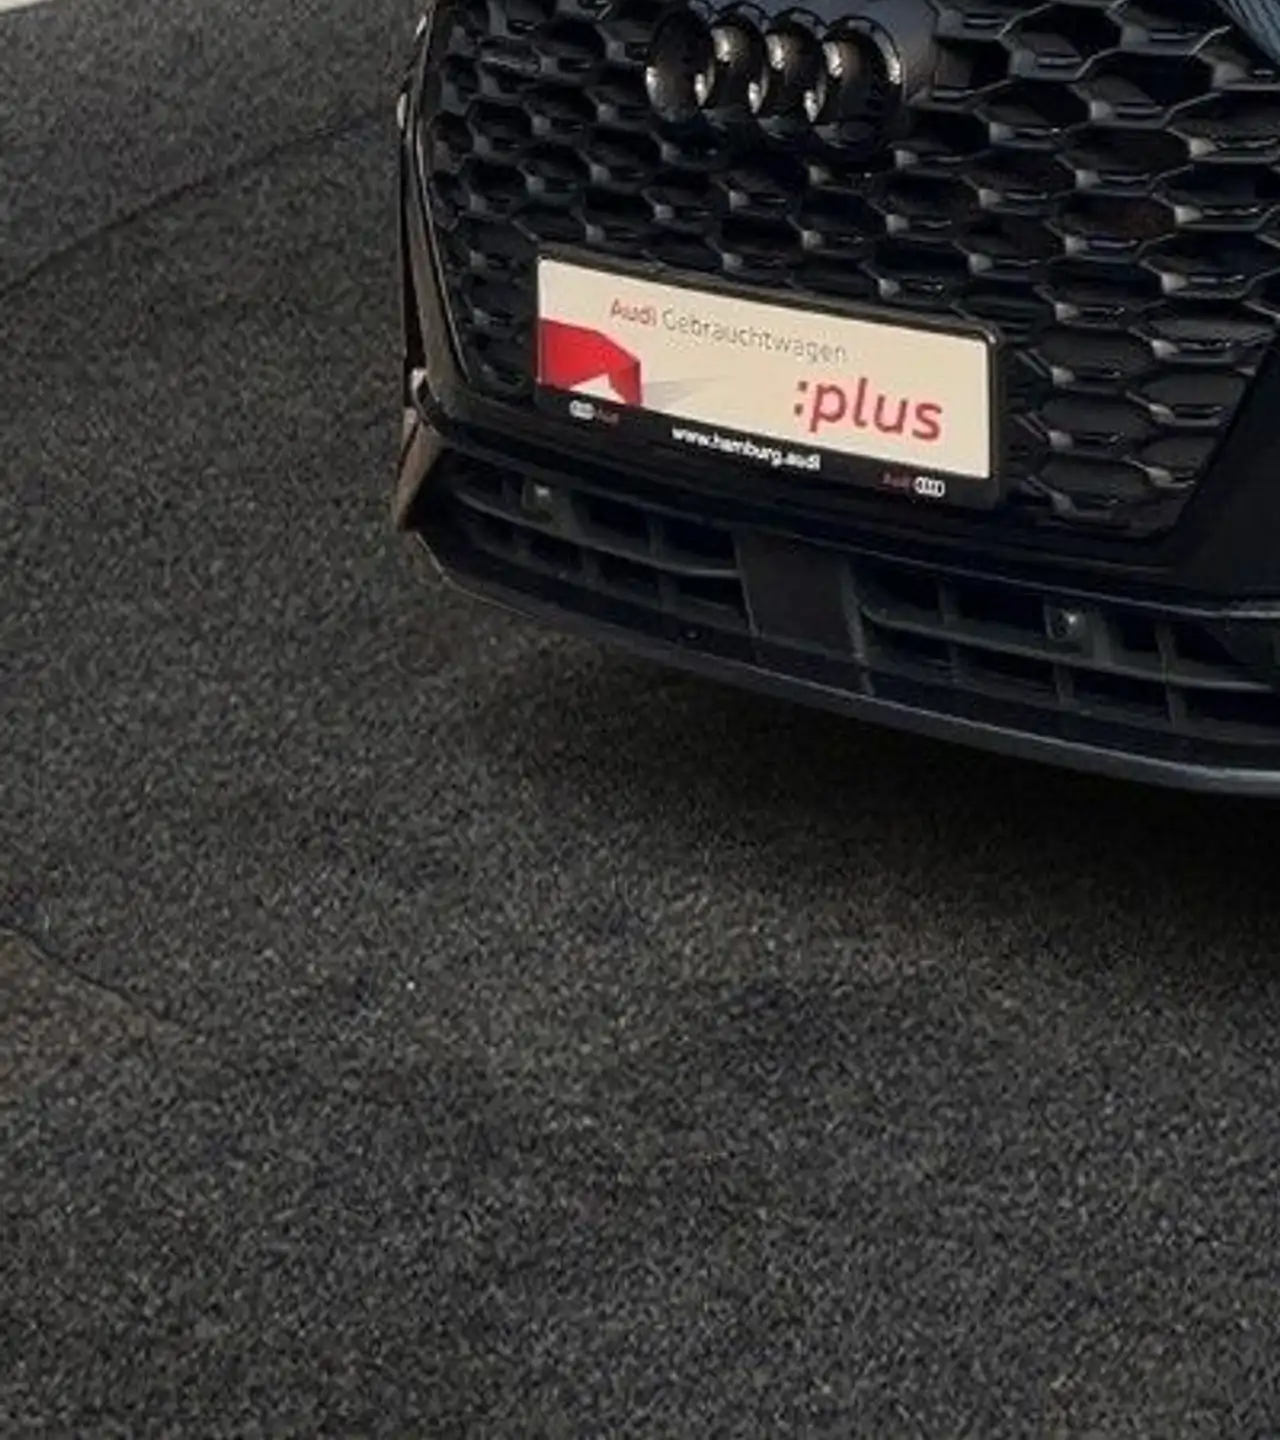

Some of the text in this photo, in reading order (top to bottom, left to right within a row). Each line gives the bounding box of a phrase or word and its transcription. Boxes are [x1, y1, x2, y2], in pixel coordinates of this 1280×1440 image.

[609, 298, 848, 364] Audi Gebrauchtwagen
[795, 378, 943, 442] :plus
